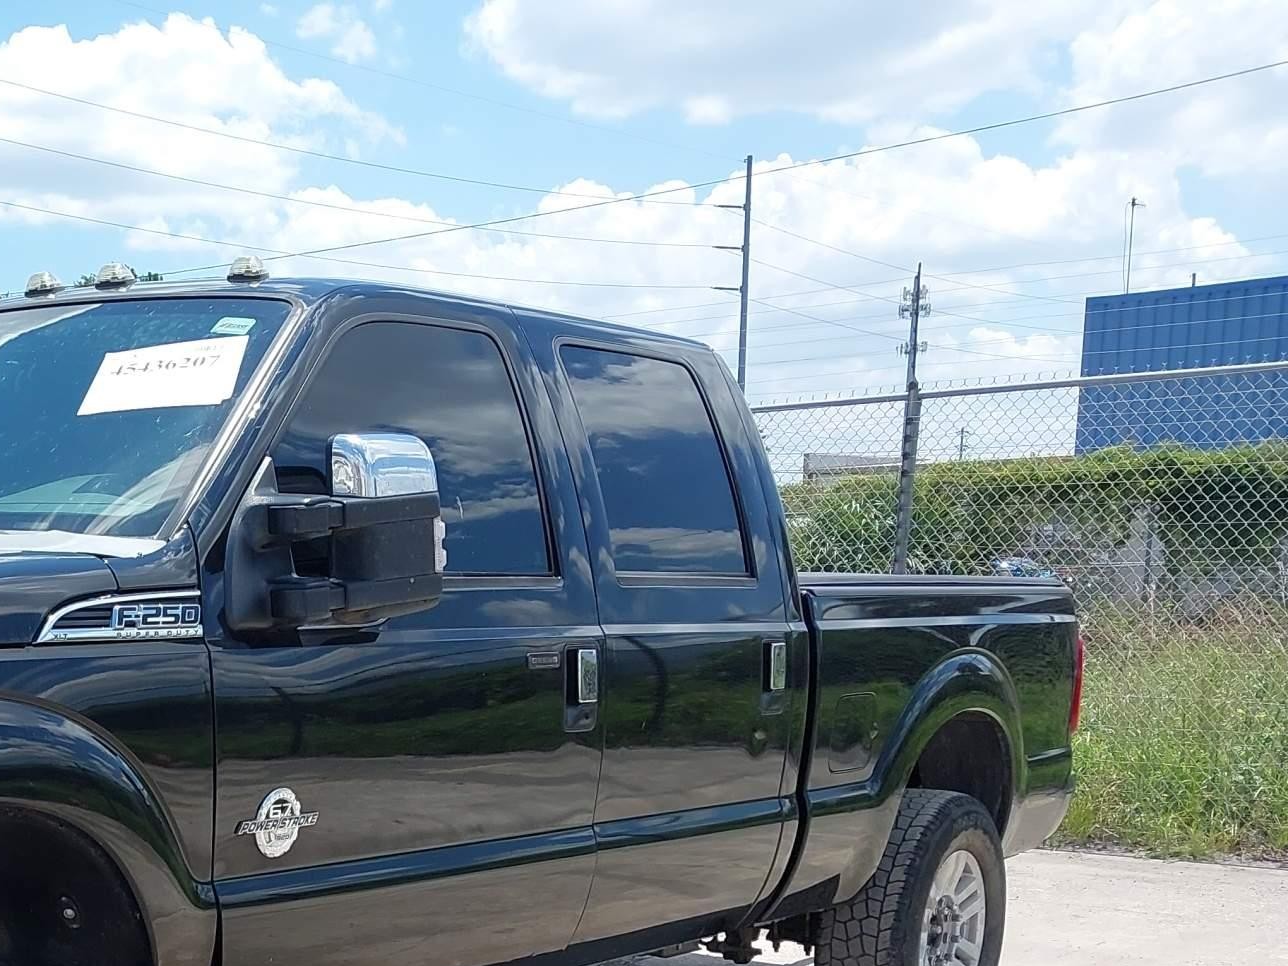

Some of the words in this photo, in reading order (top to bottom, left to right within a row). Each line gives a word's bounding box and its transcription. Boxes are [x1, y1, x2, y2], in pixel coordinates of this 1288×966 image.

[112, 604, 201, 629] F-250
[116, 631, 161, 640] SUPER
[166, 629, 200, 639] DUTY
